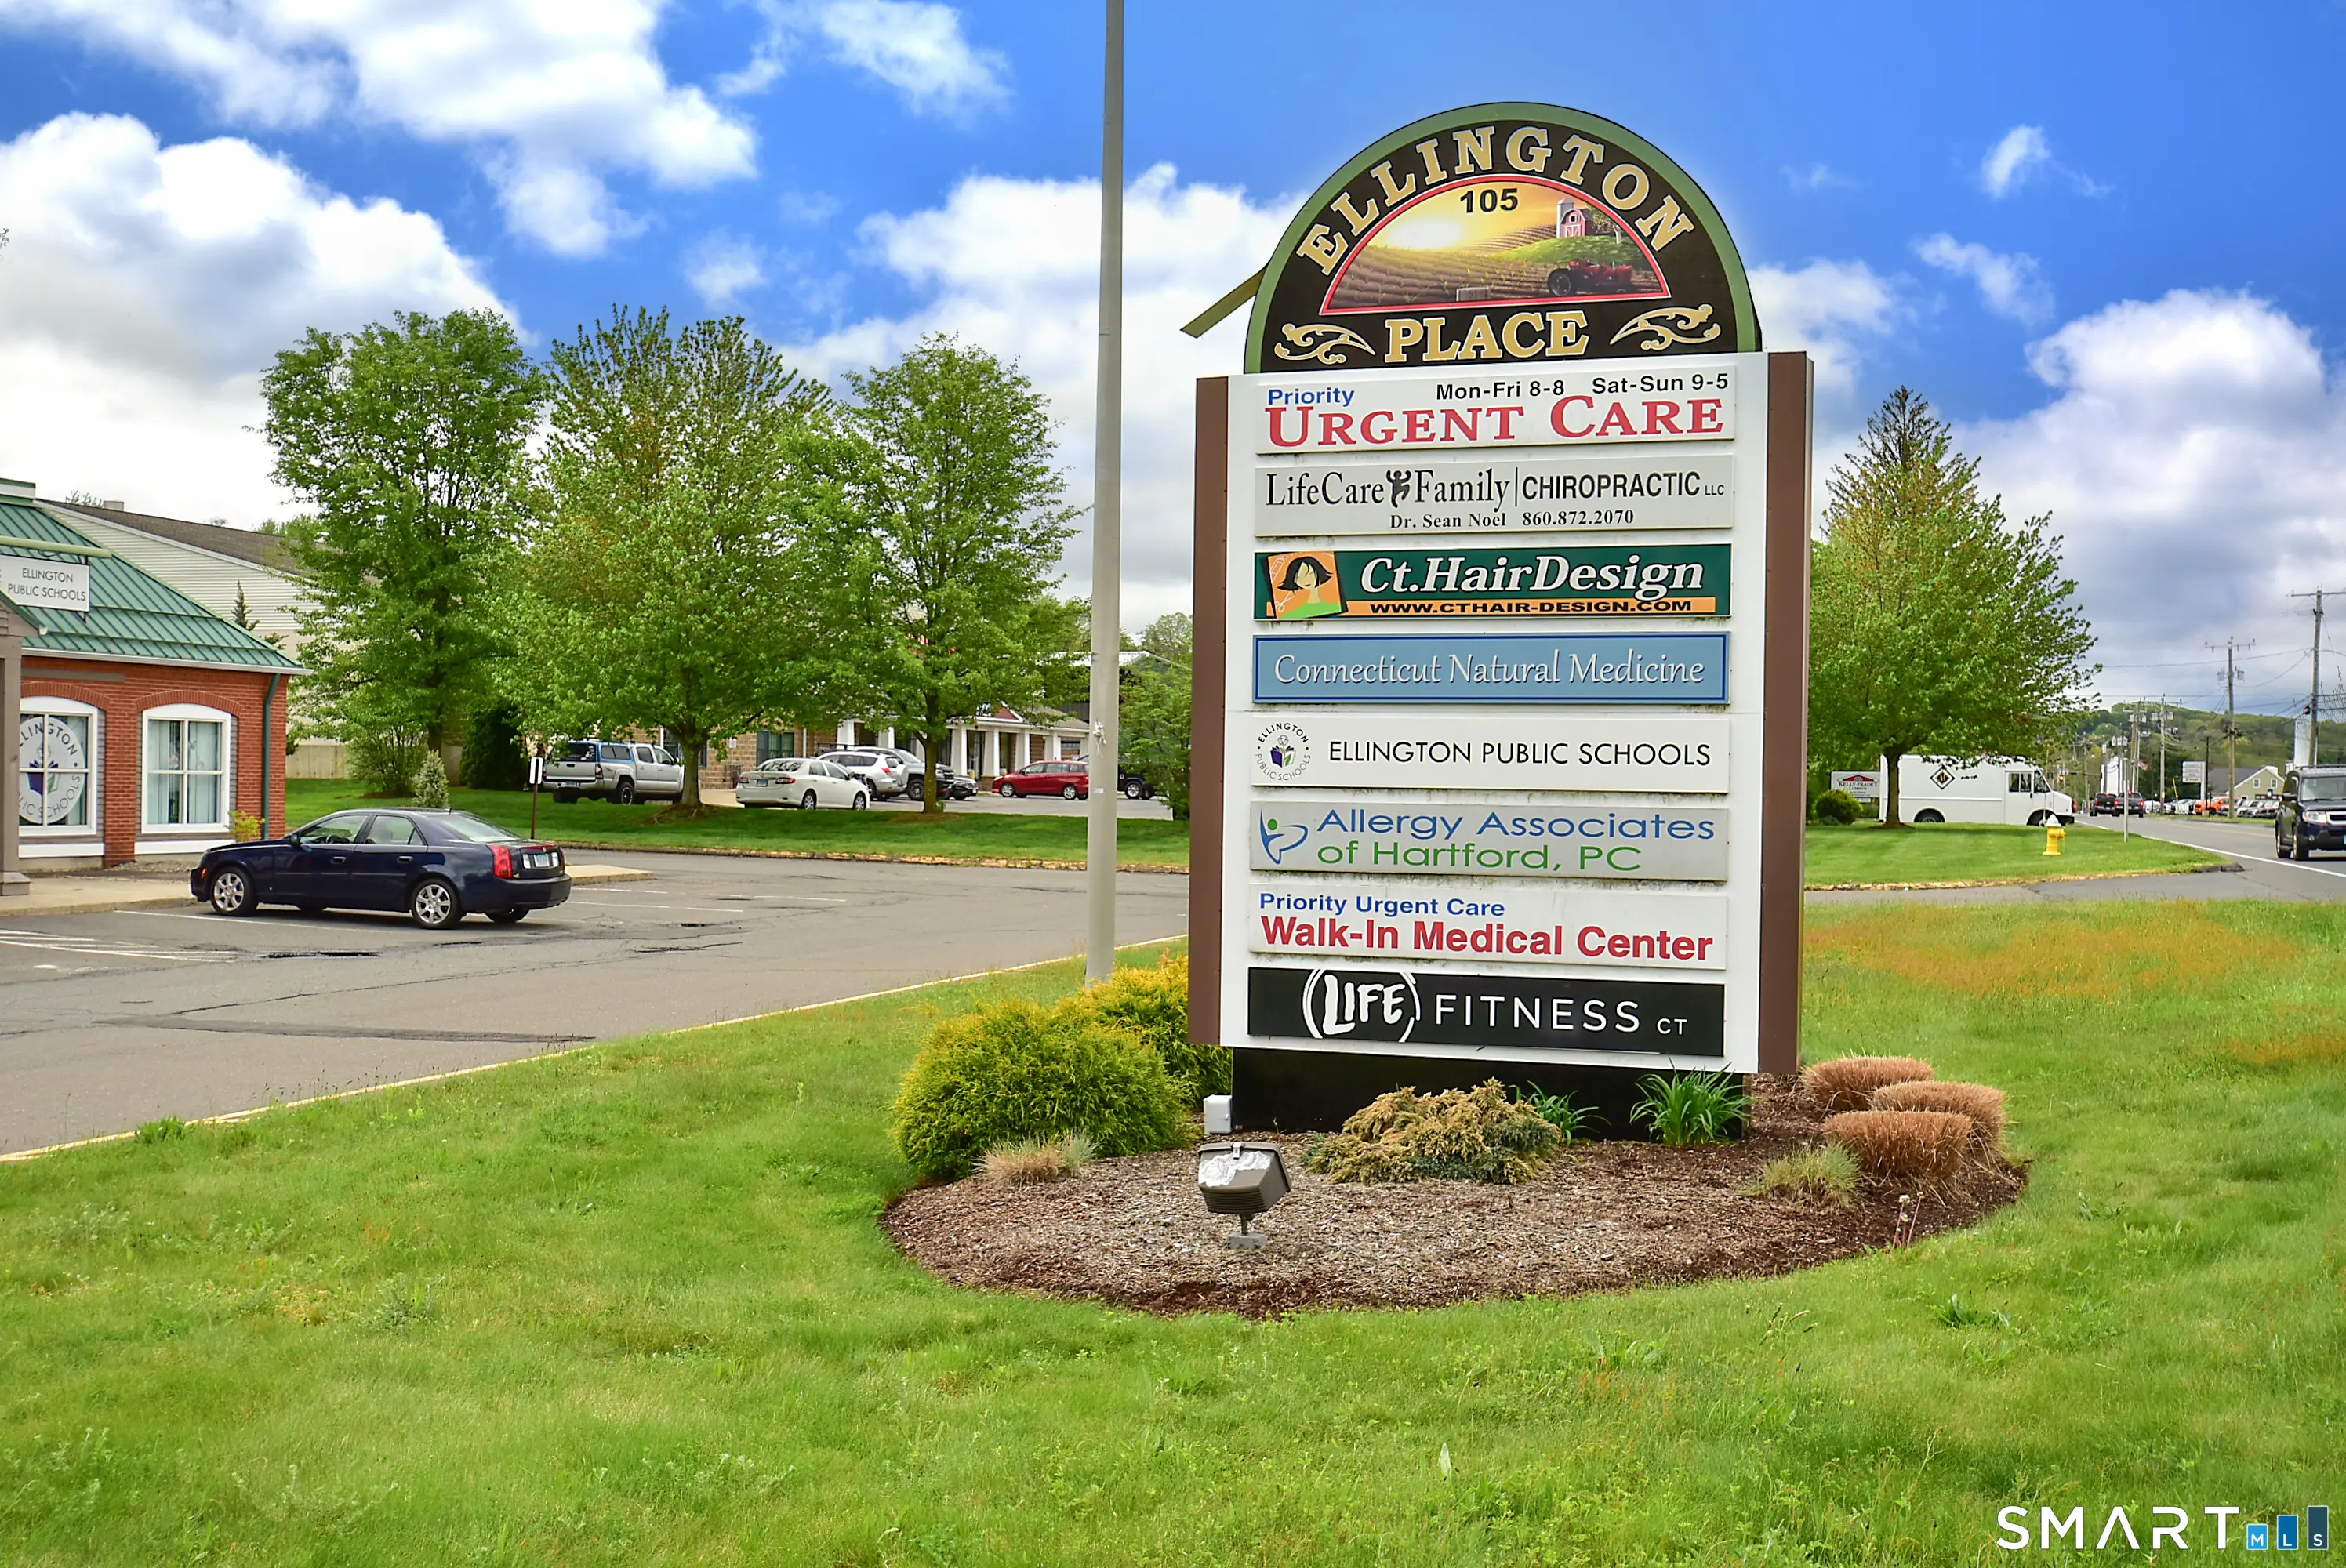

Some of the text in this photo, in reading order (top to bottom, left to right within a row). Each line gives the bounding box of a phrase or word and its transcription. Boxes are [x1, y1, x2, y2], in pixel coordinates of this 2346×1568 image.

[1296, 126, 1694, 275] ELLINGTON
[1459, 187, 1519, 213] 105
[1385, 310, 1589, 363] PLACE
[1267, 387, 1355, 407] Priority
[1436, 372, 1729, 401] Mon-Fri 8-8 Sat-Sun 9-5
[1265, 394, 1723, 447] URGENT CARE
[1266, 468, 1725, 512] LifeCare Family CHIROPRACTIC LLC
[1390, 510, 1634, 528] Dr. Sean Noel 860.872.2070
[22, 568, 73, 583] ELLINGTON
[8, 583, 86, 601] PUBLIC SCHOOLS
[1370, 600, 1692, 615] WWW.CTHAIR-DESIGN.COM
[1274, 648, 1705, 685] Connecticut Natural Medicine
[1258, 722, 1309, 743] ELLINGTON
[1255, 753, 1311, 781] PUBLIC SCHOOLS
[1330, 740, 1712, 767] ELLINGTON PUBLIC SCHOOLS
[1316, 808, 1715, 840] Allergy Associates
[1317, 840, 1642, 872] of Hartford, PC
[1259, 893, 1505, 917] Priority Urgent Care
[1261, 916, 1713, 960] Walk-In Medical Center
[1321, 974, 1687, 1035] LIFE FITNESS CT
